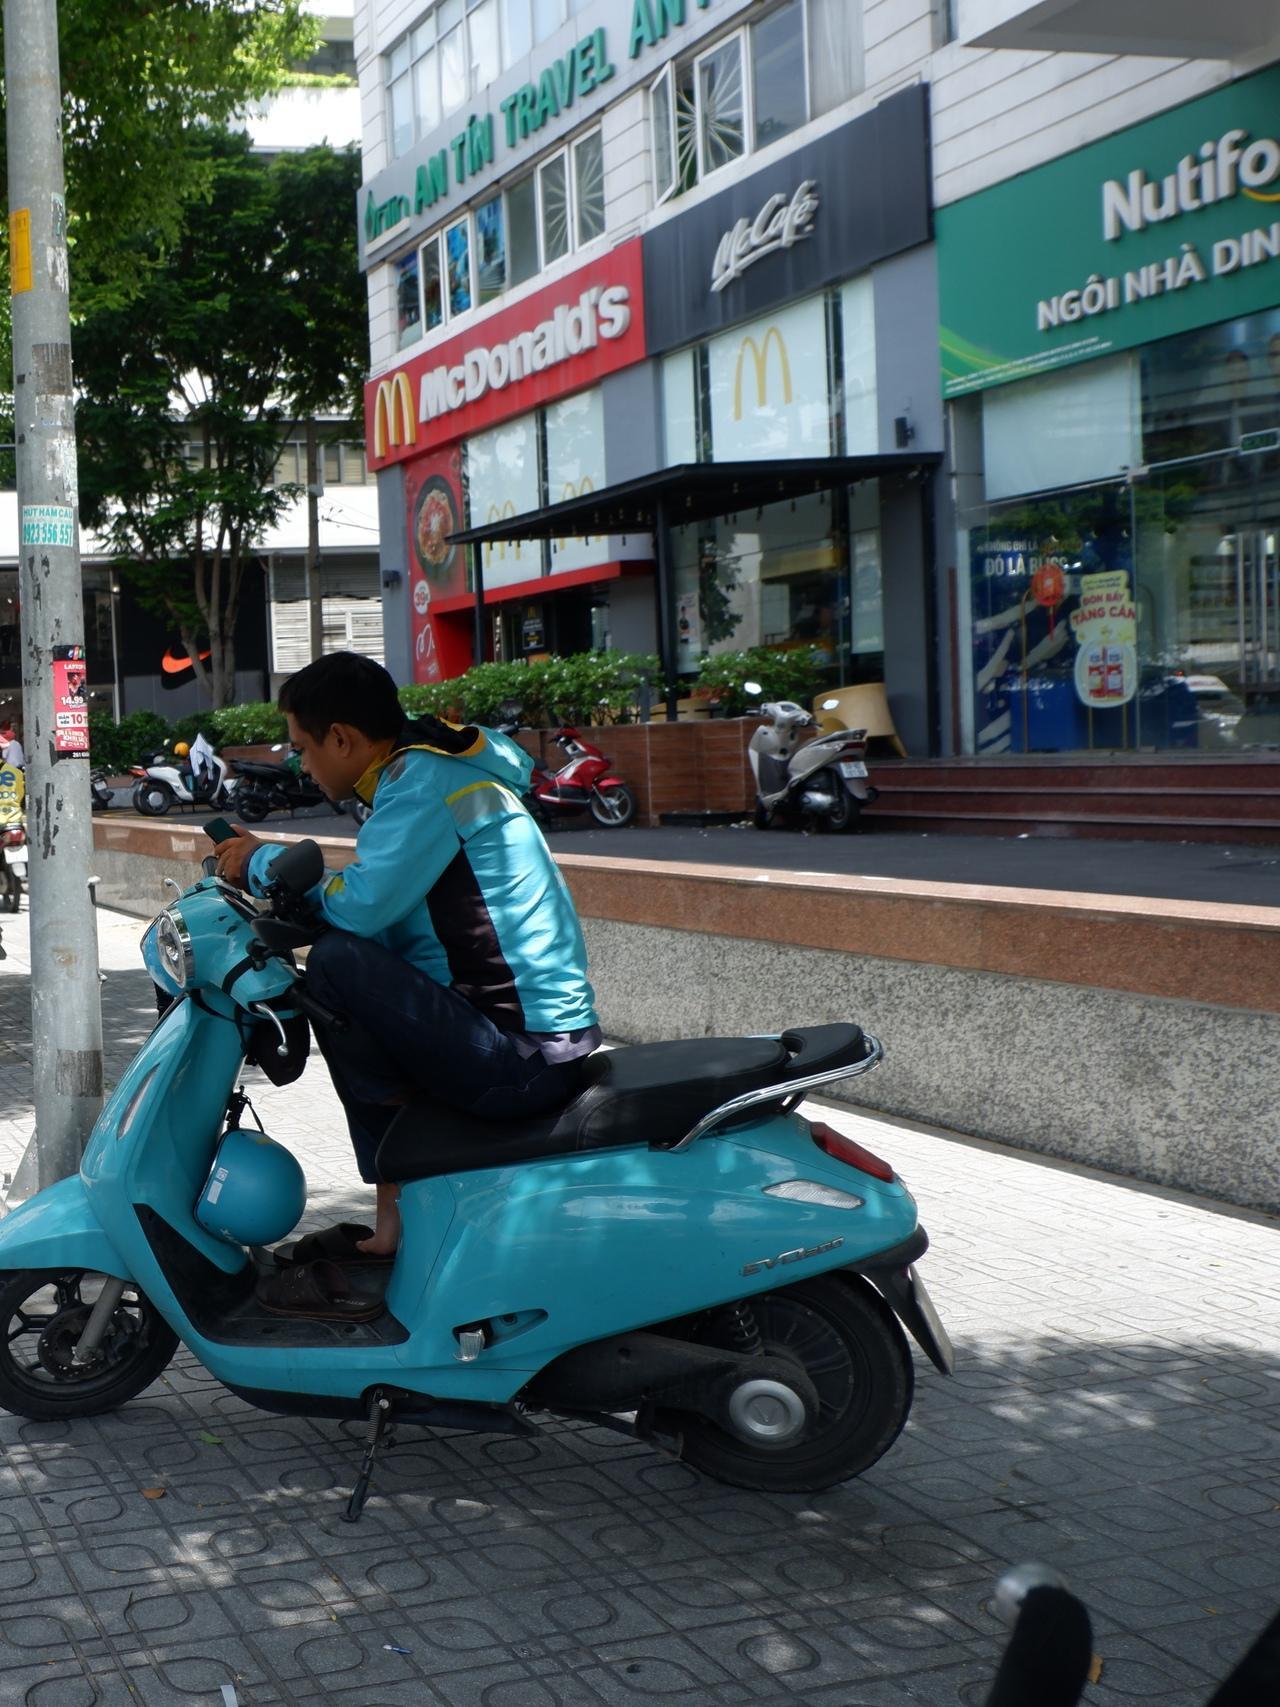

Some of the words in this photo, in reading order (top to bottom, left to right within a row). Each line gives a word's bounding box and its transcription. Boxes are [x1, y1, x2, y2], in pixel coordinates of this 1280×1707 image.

[413, 148, 449, 216] AN
[450, 113, 494, 184] TÍN
[499, 26, 616, 148] TRAVEL
[419, 285, 632, 424] McDonald's
[1037, 273, 1120, 331] NGÔI
[1124, 243, 1207, 303] NHÀ
